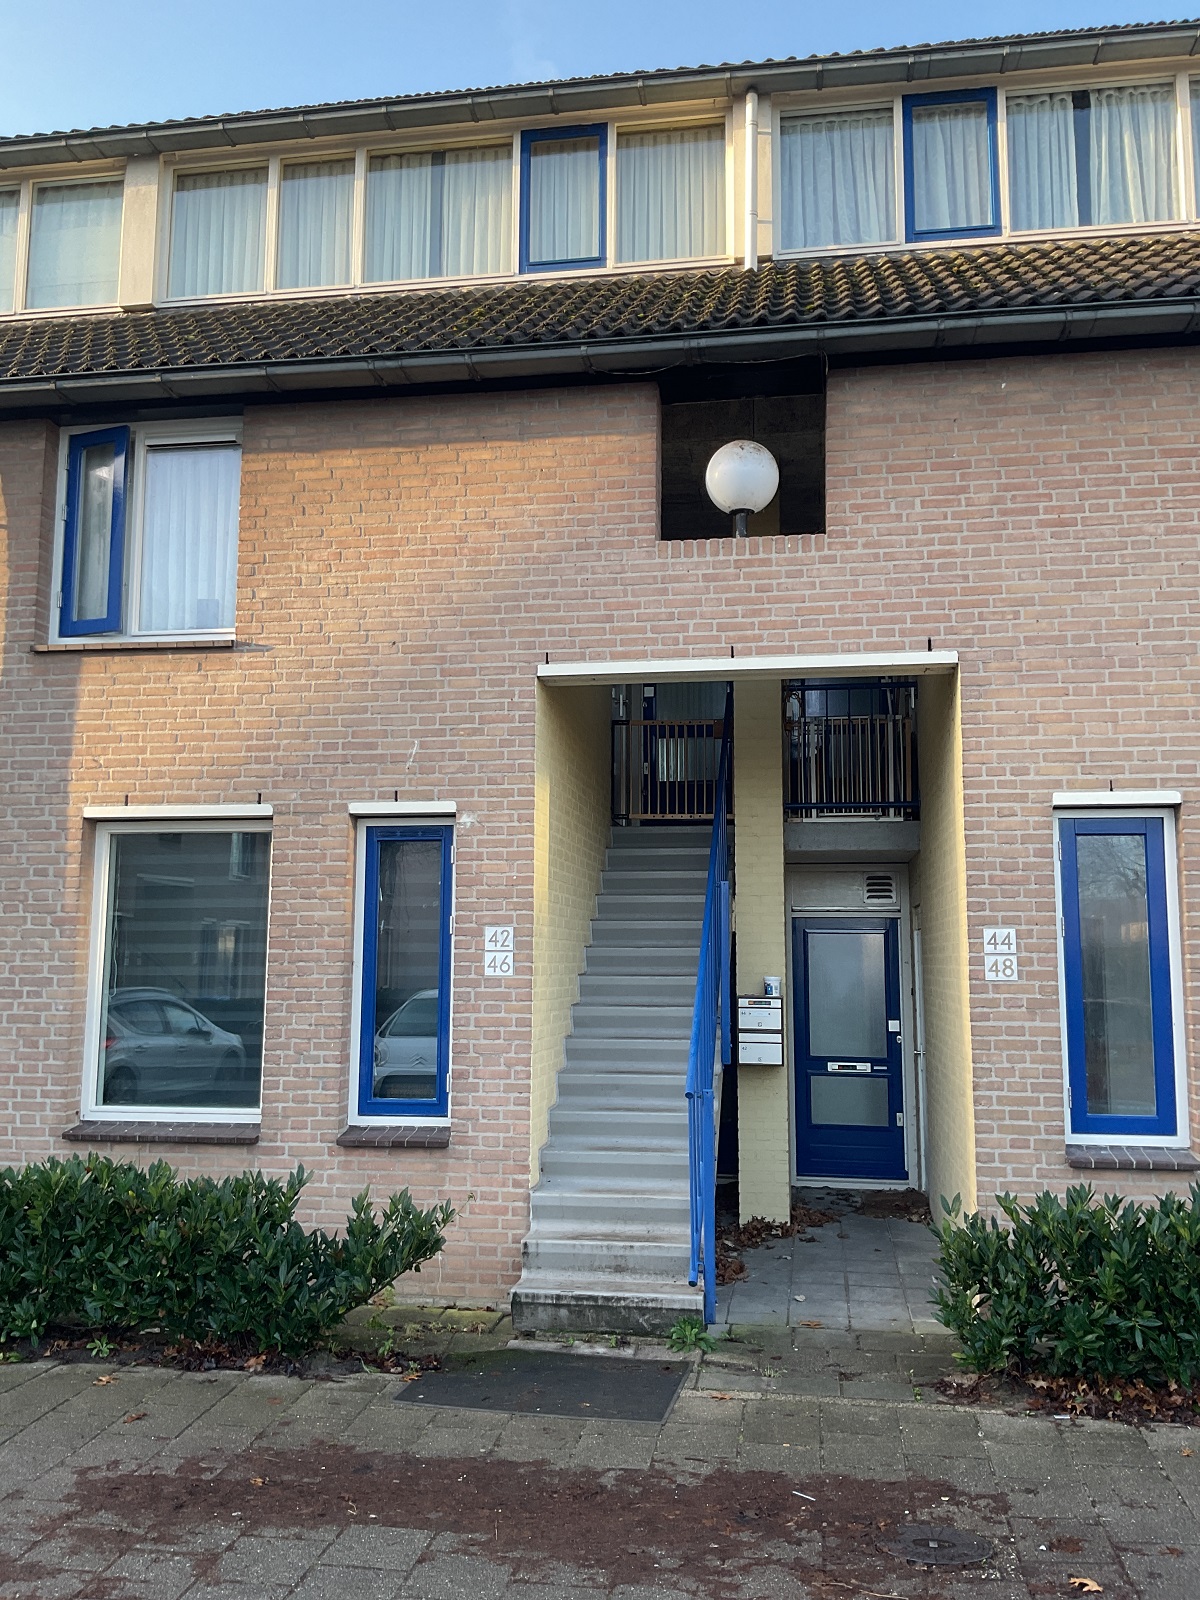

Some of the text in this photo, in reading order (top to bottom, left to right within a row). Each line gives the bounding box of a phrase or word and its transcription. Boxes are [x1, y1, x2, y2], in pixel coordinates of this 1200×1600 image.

[488, 929, 511, 948] 42
[986, 931, 1013, 951] 44
[487, 955, 511, 973] 46
[988, 958, 1015, 978] 48
